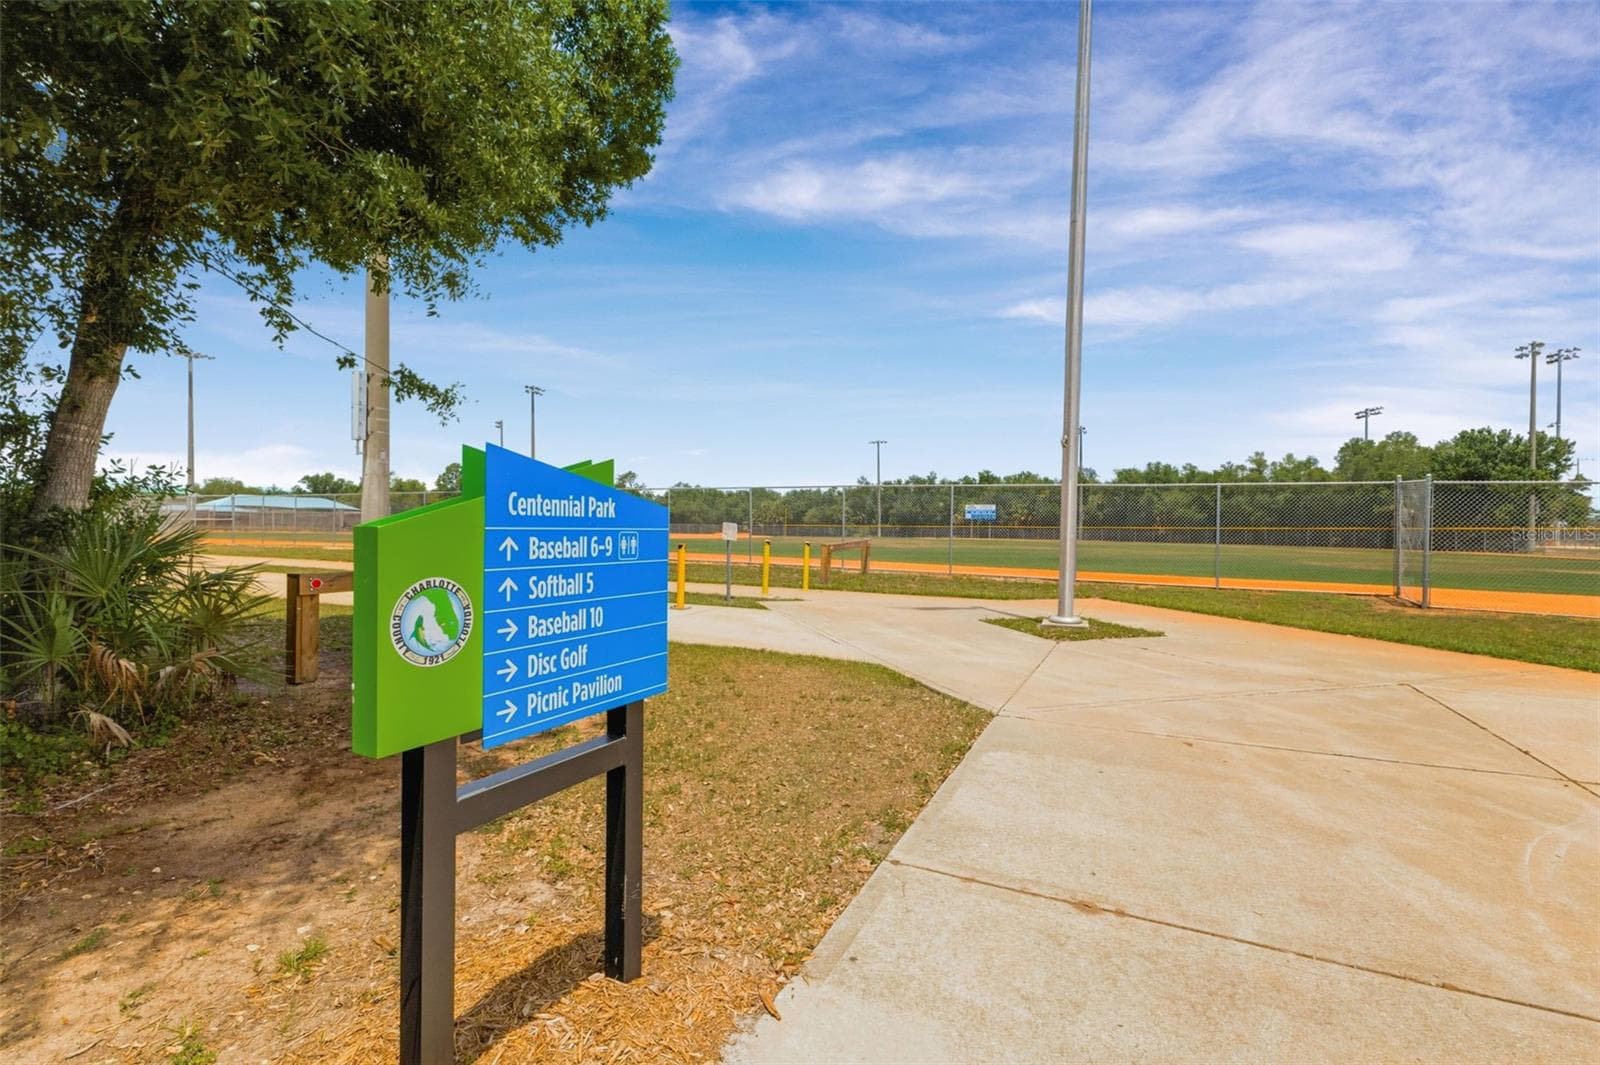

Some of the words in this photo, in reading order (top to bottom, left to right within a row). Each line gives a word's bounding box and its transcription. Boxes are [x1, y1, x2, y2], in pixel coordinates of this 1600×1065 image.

[508, 492, 584, 518] Centennial
[588, 497, 615, 518] Park
[529, 536, 587, 560] Baseball
[405, 579, 461, 600] CHARLOTTE
[529, 573, 583, 600] Softball
[586, 572, 594, 593] 5
[392, 615, 410, 656] COUNTY
[455, 604, 472, 648] FLORIDA
[528, 608, 586, 639] Baseball
[590, 606, 603, 628] 10
[423, 653, 445, 665] 1921
[528, 652, 557, 678] Disc
[560, 644, 588, 669] Golf
[527, 687, 569, 717] Picnic
[573, 674, 622, 706] Pavilion
